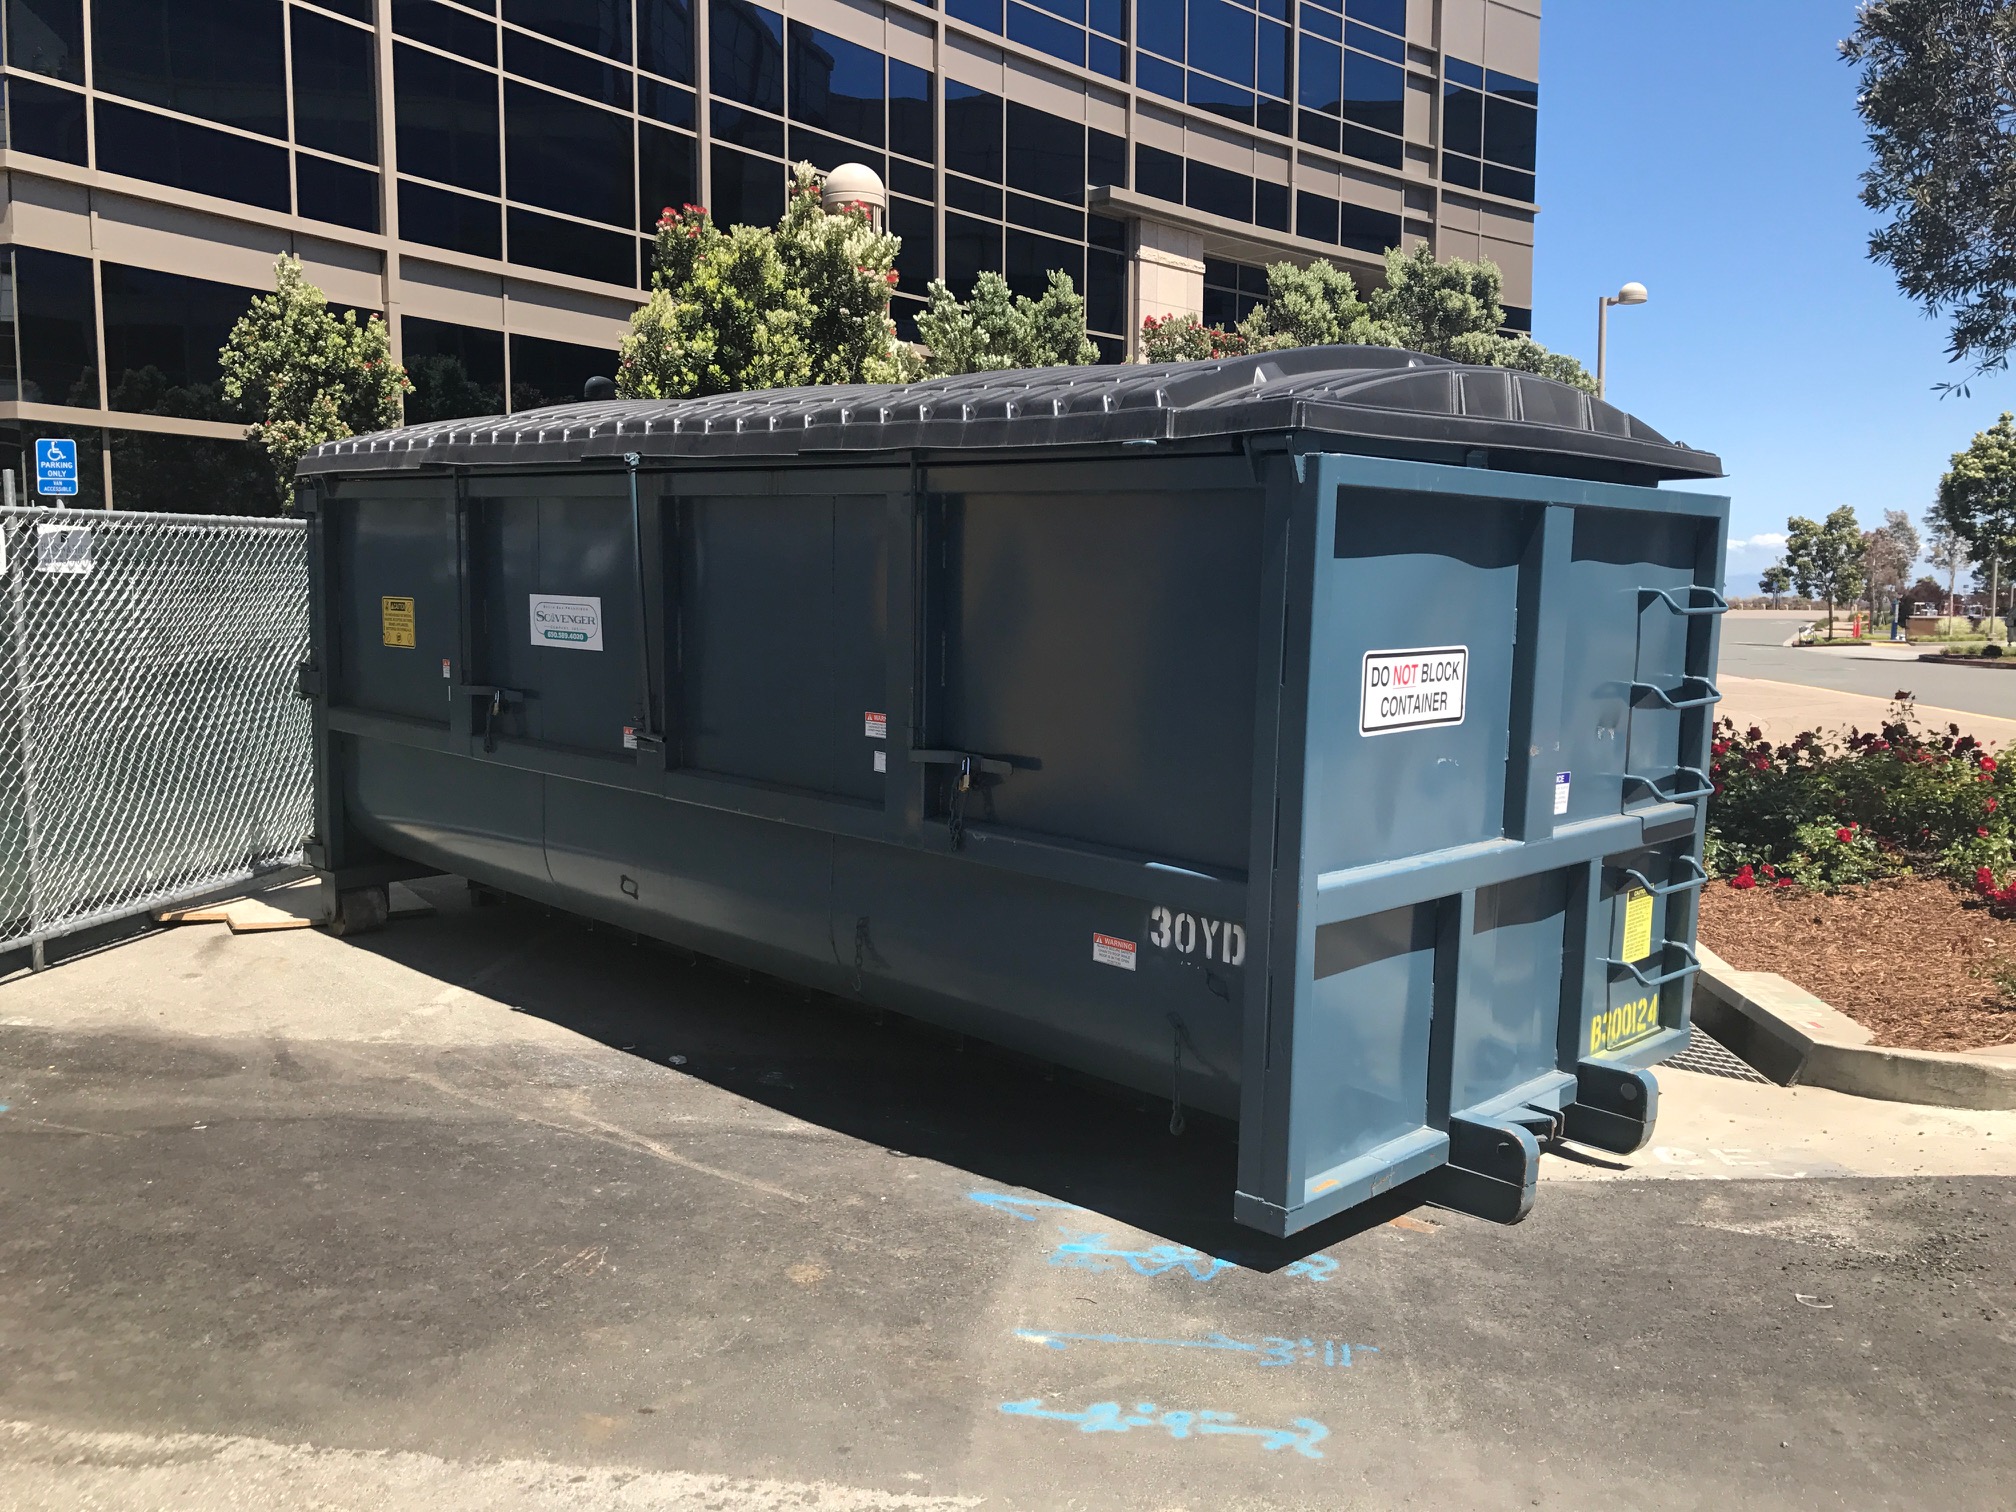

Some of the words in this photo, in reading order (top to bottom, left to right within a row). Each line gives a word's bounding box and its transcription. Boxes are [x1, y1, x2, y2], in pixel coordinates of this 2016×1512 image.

[40, 461, 73, 469] PARKING
[536, 610, 596, 625] SCAVENGER
[1371, 666, 1390, 687] DO
[1393, 664, 1418, 686] NOT
[1421, 661, 1460, 683] BLOCK
[1380, 691, 1448, 718] CONTAINER
[1104, 938, 1132, 950] WARNING
[1590, 993, 1658, 1052] B300124
